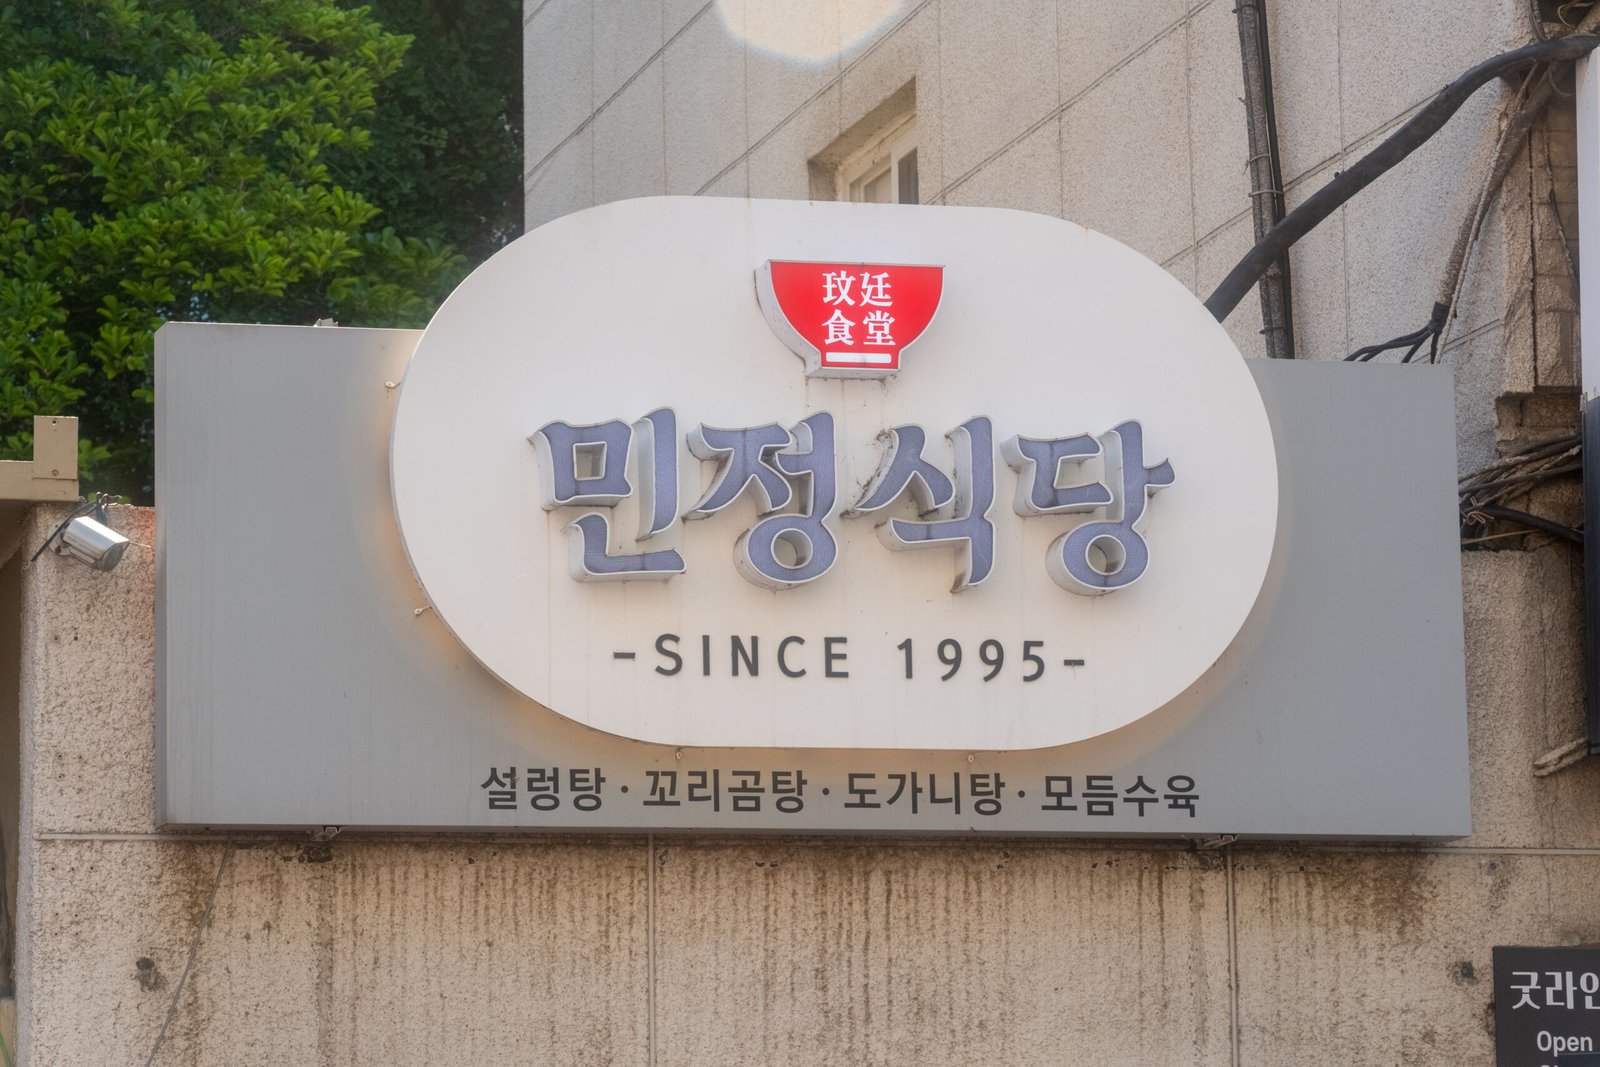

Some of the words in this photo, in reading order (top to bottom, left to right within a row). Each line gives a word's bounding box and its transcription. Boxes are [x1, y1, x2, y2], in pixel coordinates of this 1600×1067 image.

[821, 309, 897, 346] 食堂
[527, 405, 1176, 596] 민정식당
[480, 766, 606, 812] 설렁탕
[643, 768, 808, 814] 꼬리곰탕
[844, 771, 1006, 816] 도가니탕
[1041, 775, 1200, 818] 모듬수육
[1536, 1030, 1593, 1058] Open
